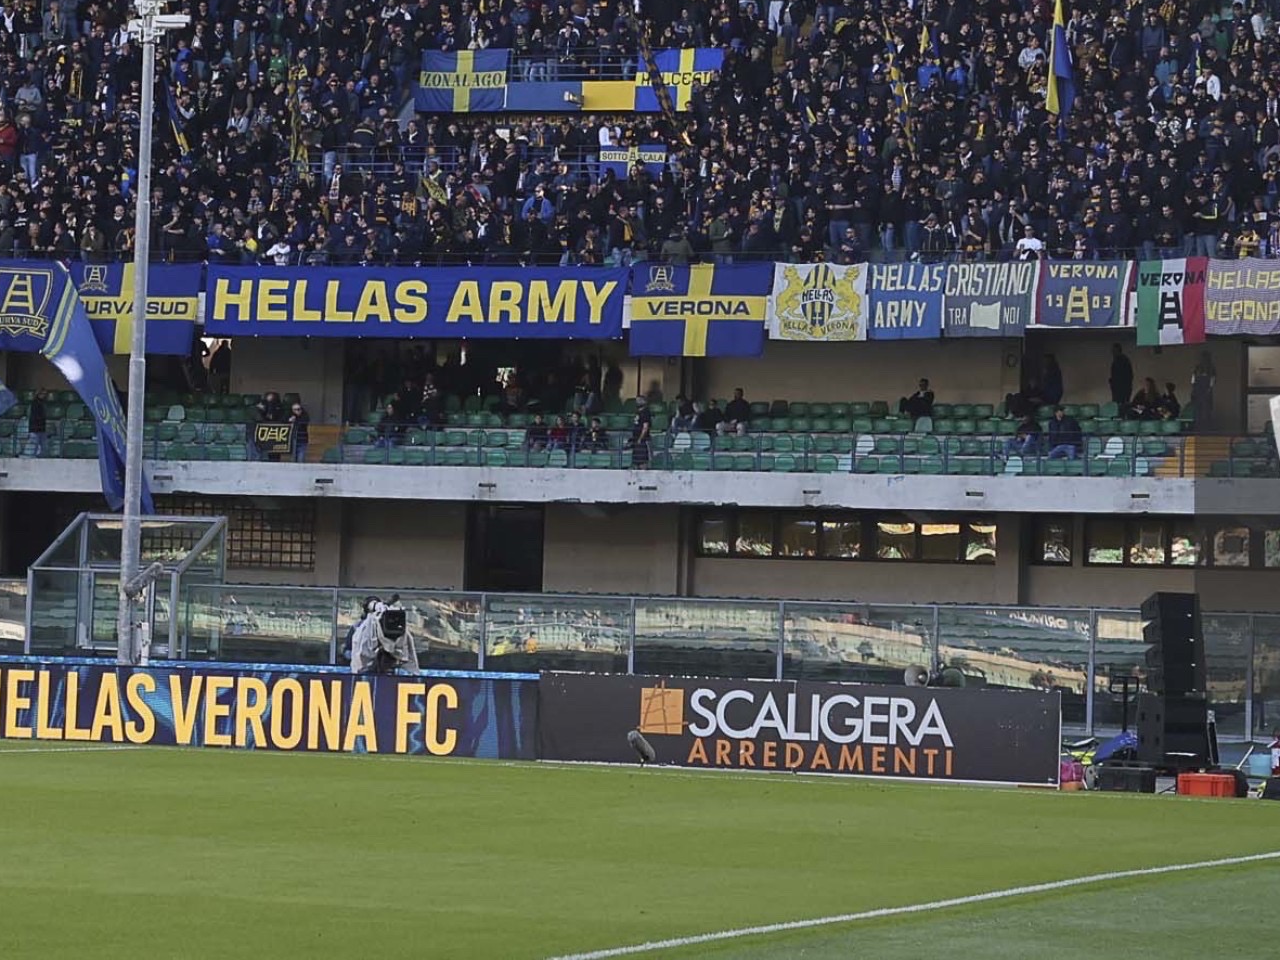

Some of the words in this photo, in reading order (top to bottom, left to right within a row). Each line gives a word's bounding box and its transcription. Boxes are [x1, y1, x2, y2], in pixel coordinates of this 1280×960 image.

[602, 152, 627, 161] SOTTO
[872, 264, 944, 292] HELLAS
[945, 262, 1032, 296] CRISTIANO
[1049, 265, 1118, 278] VERONA
[1140, 271, 1205, 287] VERONA
[146, 302, 188, 316] SUD
[213, 278, 427, 322] HELLAS
[446, 280, 618, 324] ARMY
[647, 301, 750, 316] VERONA
[24, 317, 40, 327] SUD
[874, 300, 927, 328] ARMY
[948, 307, 967, 325] TRA
[170, 674, 378, 753] VERONA
[396, 682, 458, 756] FC
[688, 688, 954, 747] SCALIGERA
[687, 739, 954, 775] ARREDAMENTI
